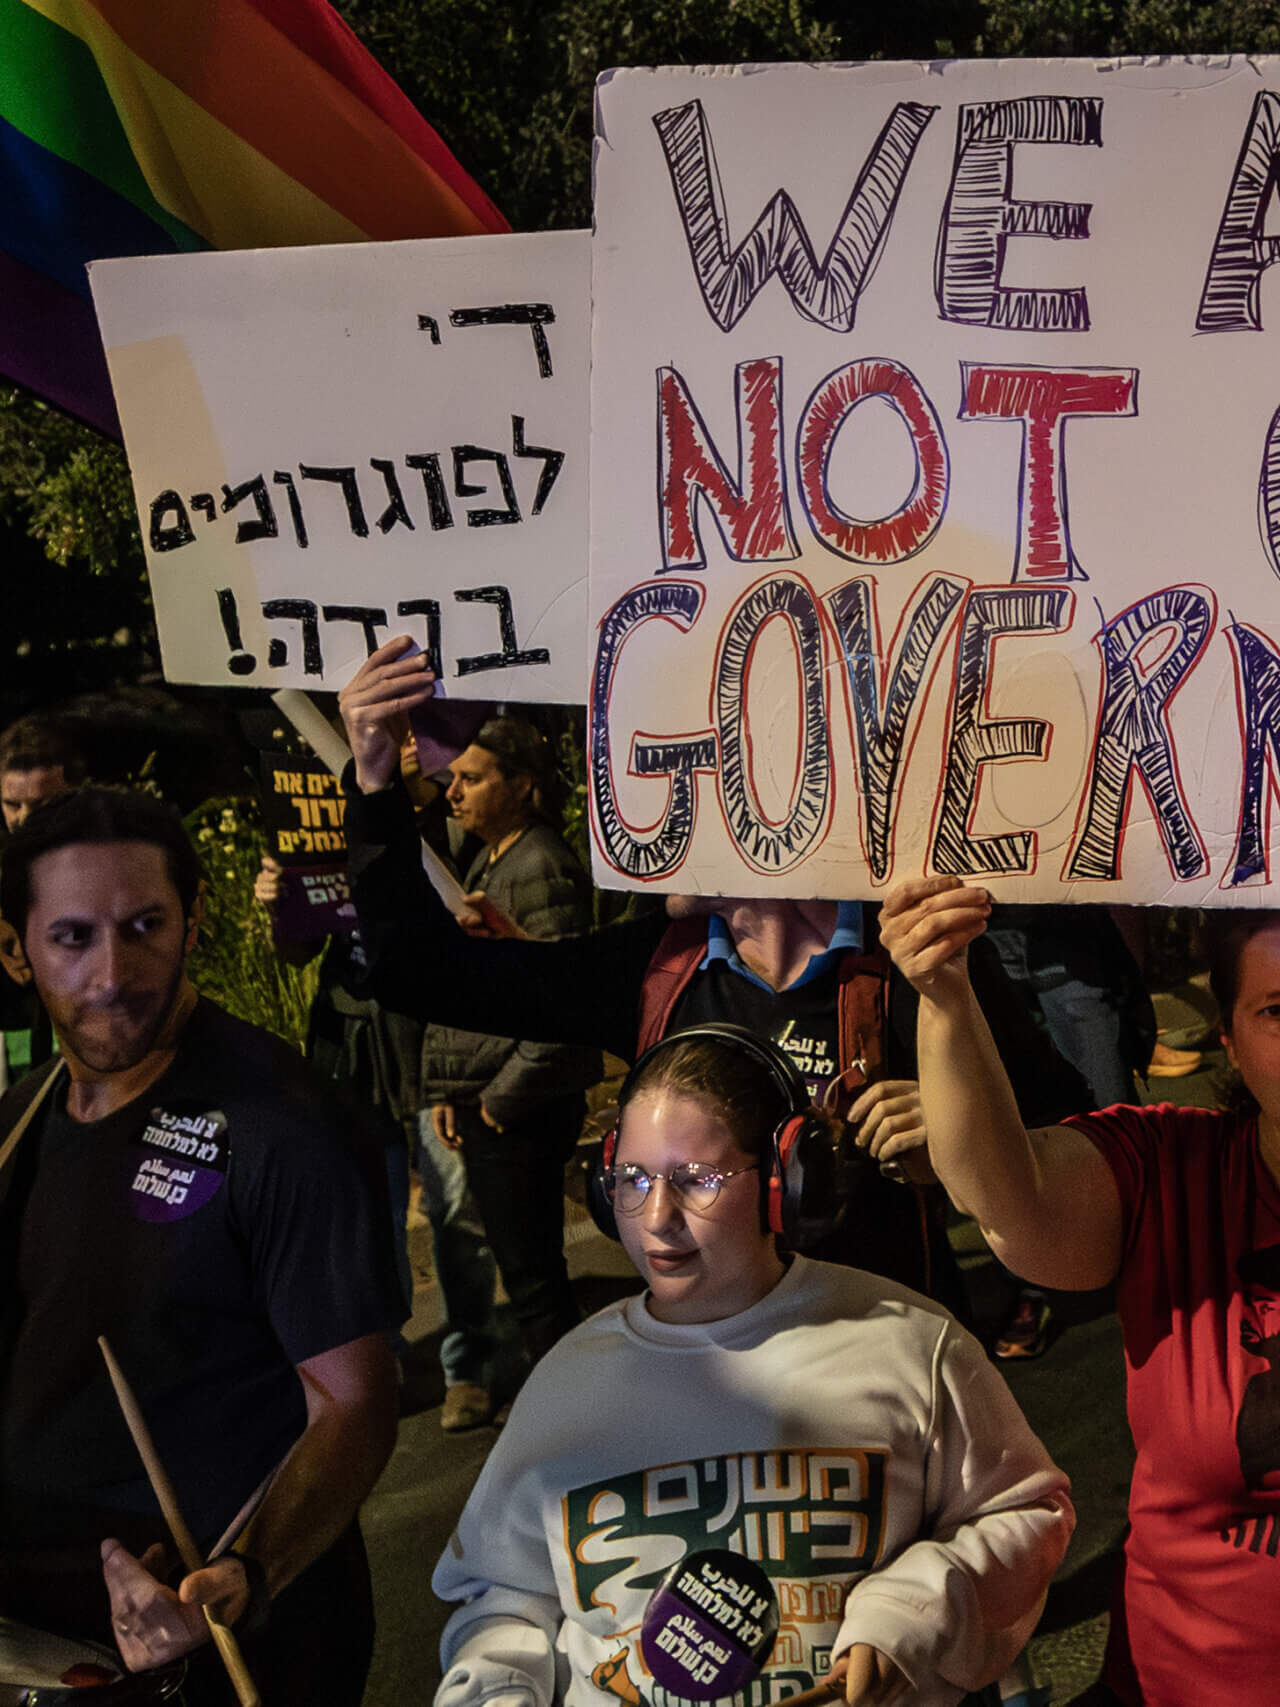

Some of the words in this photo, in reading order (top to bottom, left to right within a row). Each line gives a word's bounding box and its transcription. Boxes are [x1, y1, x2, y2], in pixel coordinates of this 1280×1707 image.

[652, 94, 1104, 334] WE
[416, 303, 556, 379] די
[149, 414, 566, 554] לפוגרומים
[655, 355, 1139, 582] NOT
[273, 769, 305, 795] את
[813, 1058, 835, 1076] לא
[160, 1111, 207, 1135] للحرب
[203, 1121, 219, 1139] لا
[142, 1125, 199, 1156] למלחמה
[196, 1142, 219, 1162] לא
[131, 1173, 173, 1200] שלום
[643, 1453, 869, 1535] משנים
[676, 1570, 744, 1630] למלחמה
[701, 1562, 757, 1608] للحرب
[777, 1578, 850, 1623] נחנו
[750, 1596, 769, 1619] لا
[666, 1613, 704, 1644] سلام
[736, 1619, 764, 1647] לא
[654, 1626, 702, 1672] שלום
[698, 1640, 732, 1664] نعم
